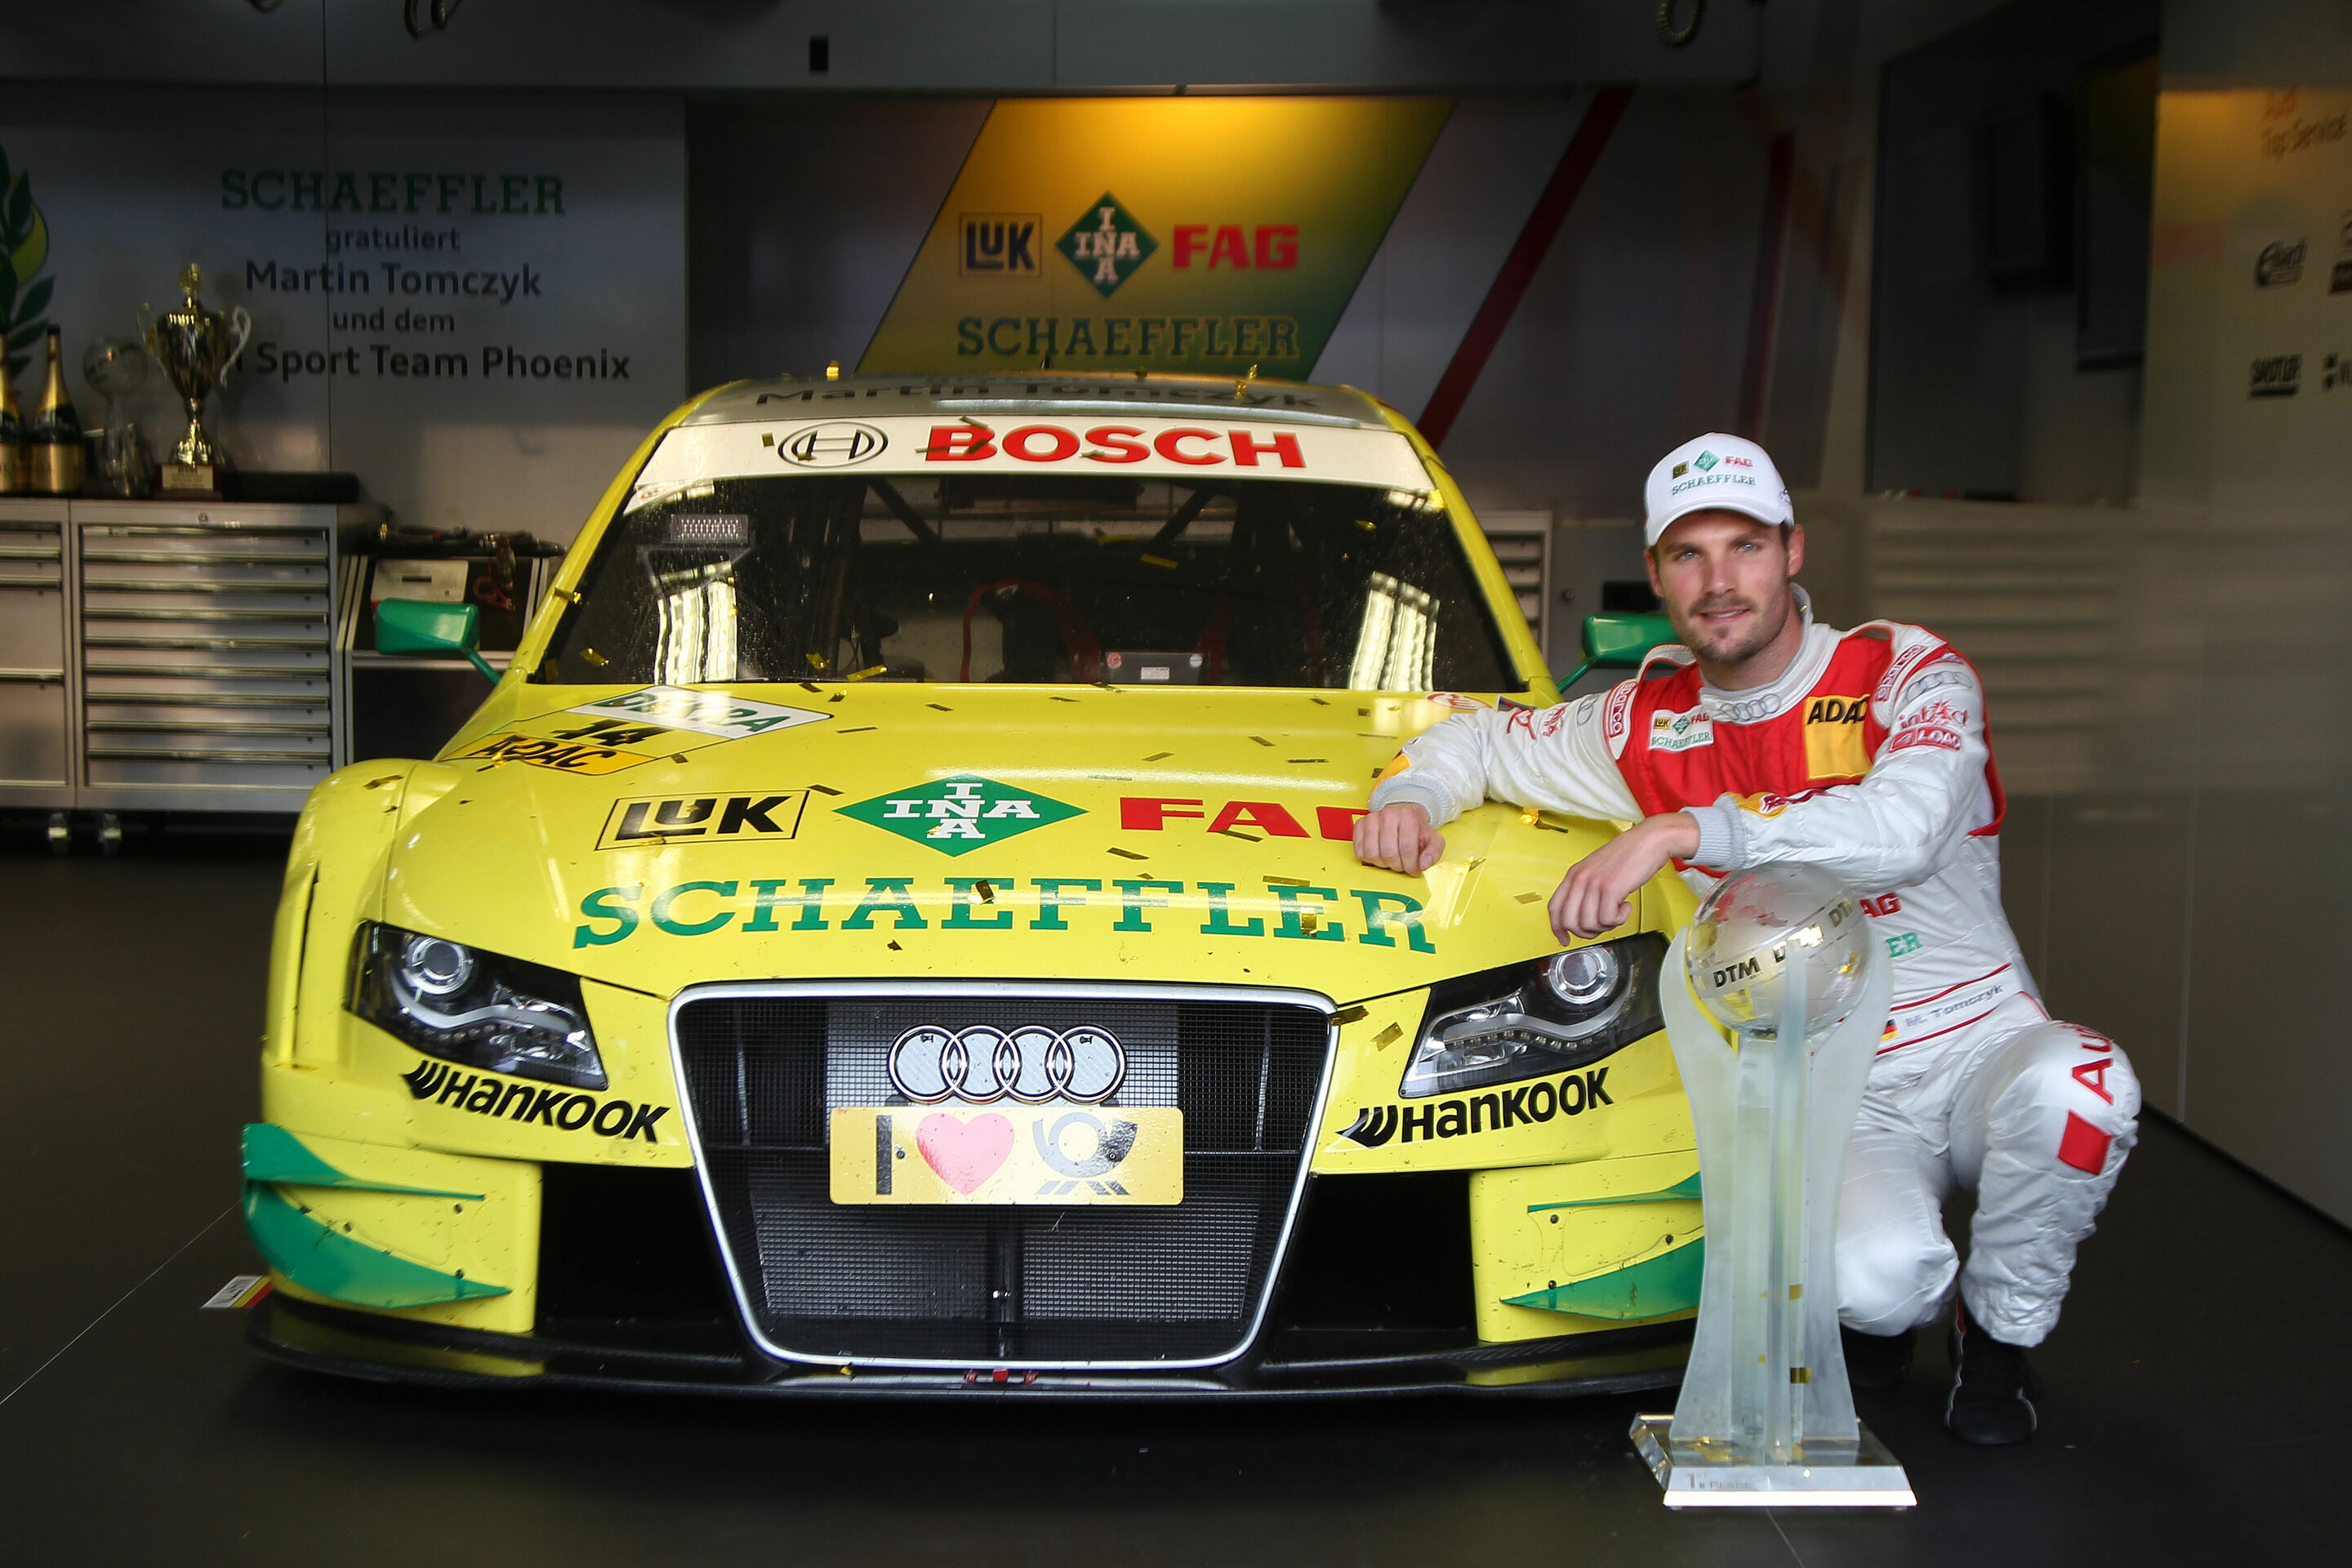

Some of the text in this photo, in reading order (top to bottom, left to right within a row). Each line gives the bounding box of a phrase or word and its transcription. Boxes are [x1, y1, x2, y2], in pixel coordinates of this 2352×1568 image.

[221, 168, 565, 216] SCHAEFFLER
[327, 225, 461, 255] gratuliert
[1172, 225, 1298, 270] FAG
[247, 259, 541, 304] Martin Tomczyk
[333, 306, 455, 332] und dem
[957, 315, 1301, 358] SCHAEFFLER
[256, 341, 360, 382] Sport
[370, 343, 468, 377] Team
[483, 345, 630, 380] Phoenix
[756, 384, 1319, 408] Martin Tomczyk
[925, 424, 1307, 469] BOSCH
[1672, 474, 1757, 496] SCHAEFFLER
[549, 719, 675, 746] 14
[466, 734, 617, 768] ADAC
[572, 877, 1437, 954] SCHAEFFLER
[1713, 956, 1762, 989] DTM
[1931, 984, 2004, 1018] Tomczyk
